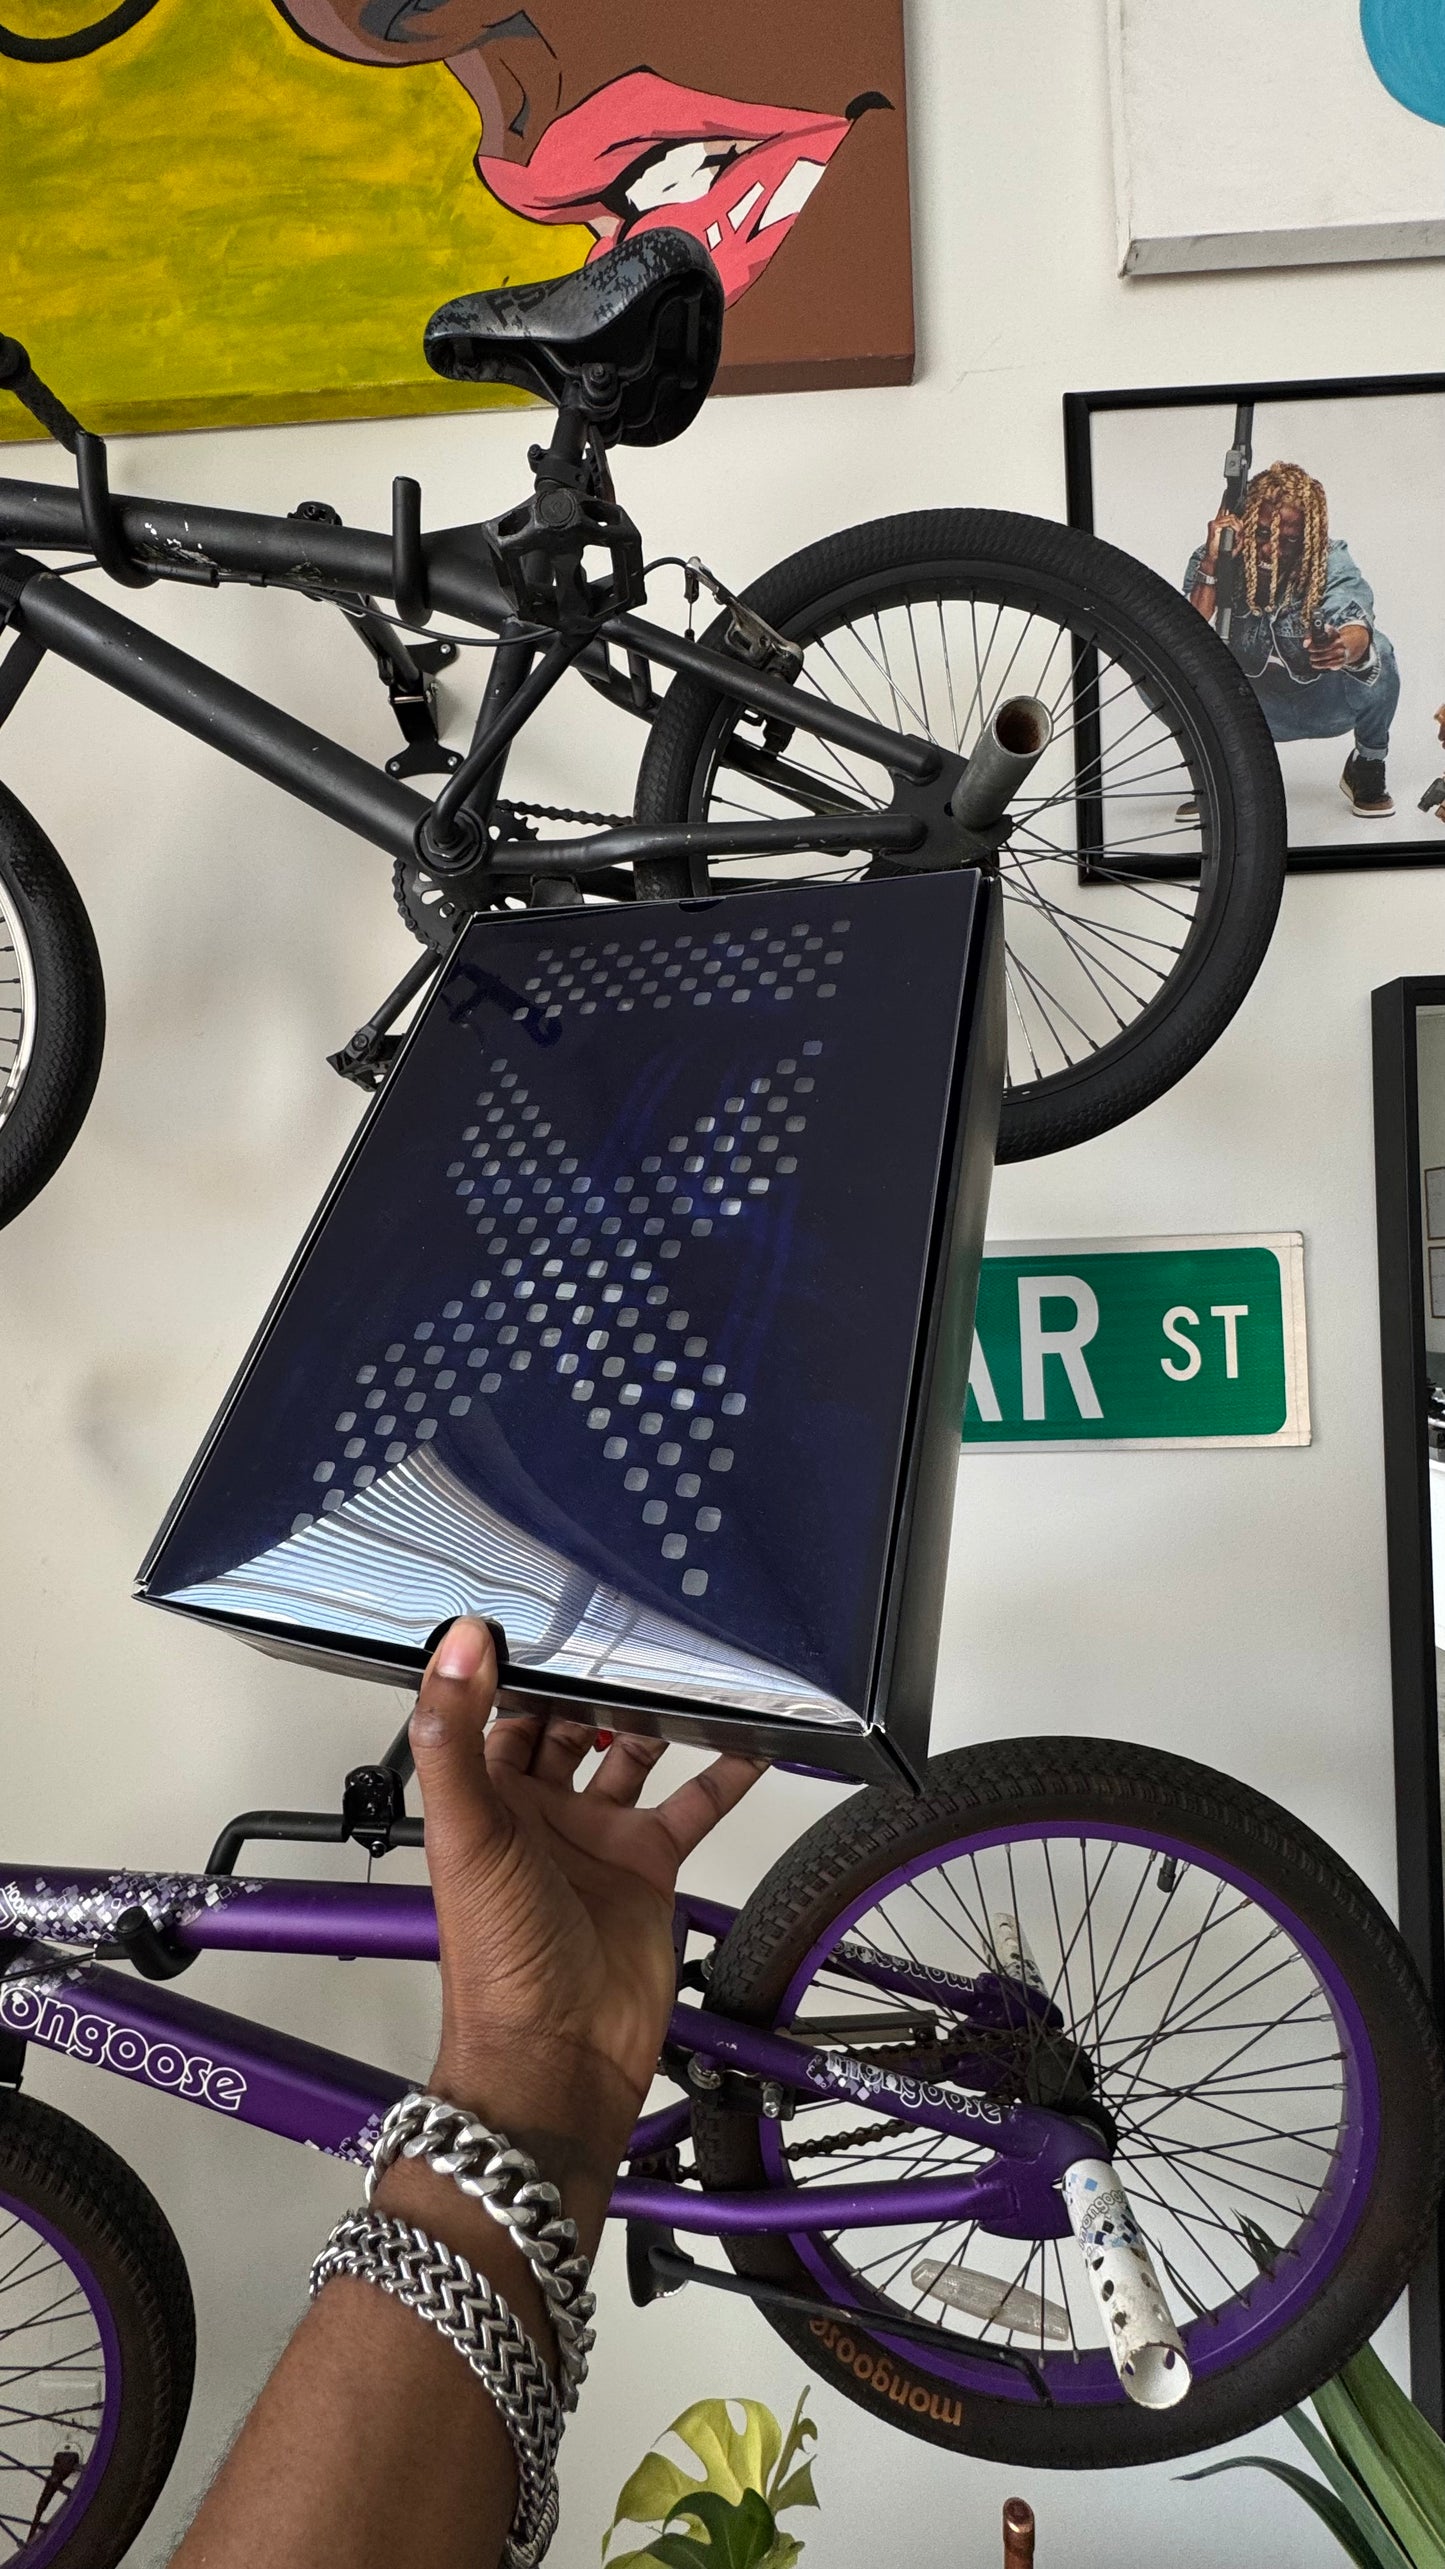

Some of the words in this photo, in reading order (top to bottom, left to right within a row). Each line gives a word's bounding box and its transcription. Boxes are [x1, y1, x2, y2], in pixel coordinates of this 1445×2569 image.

[1160, 1304, 1249, 1382] ST
[0, 1986, 248, 2111] ongoose
[809, 2316, 962, 2427] mongoose
